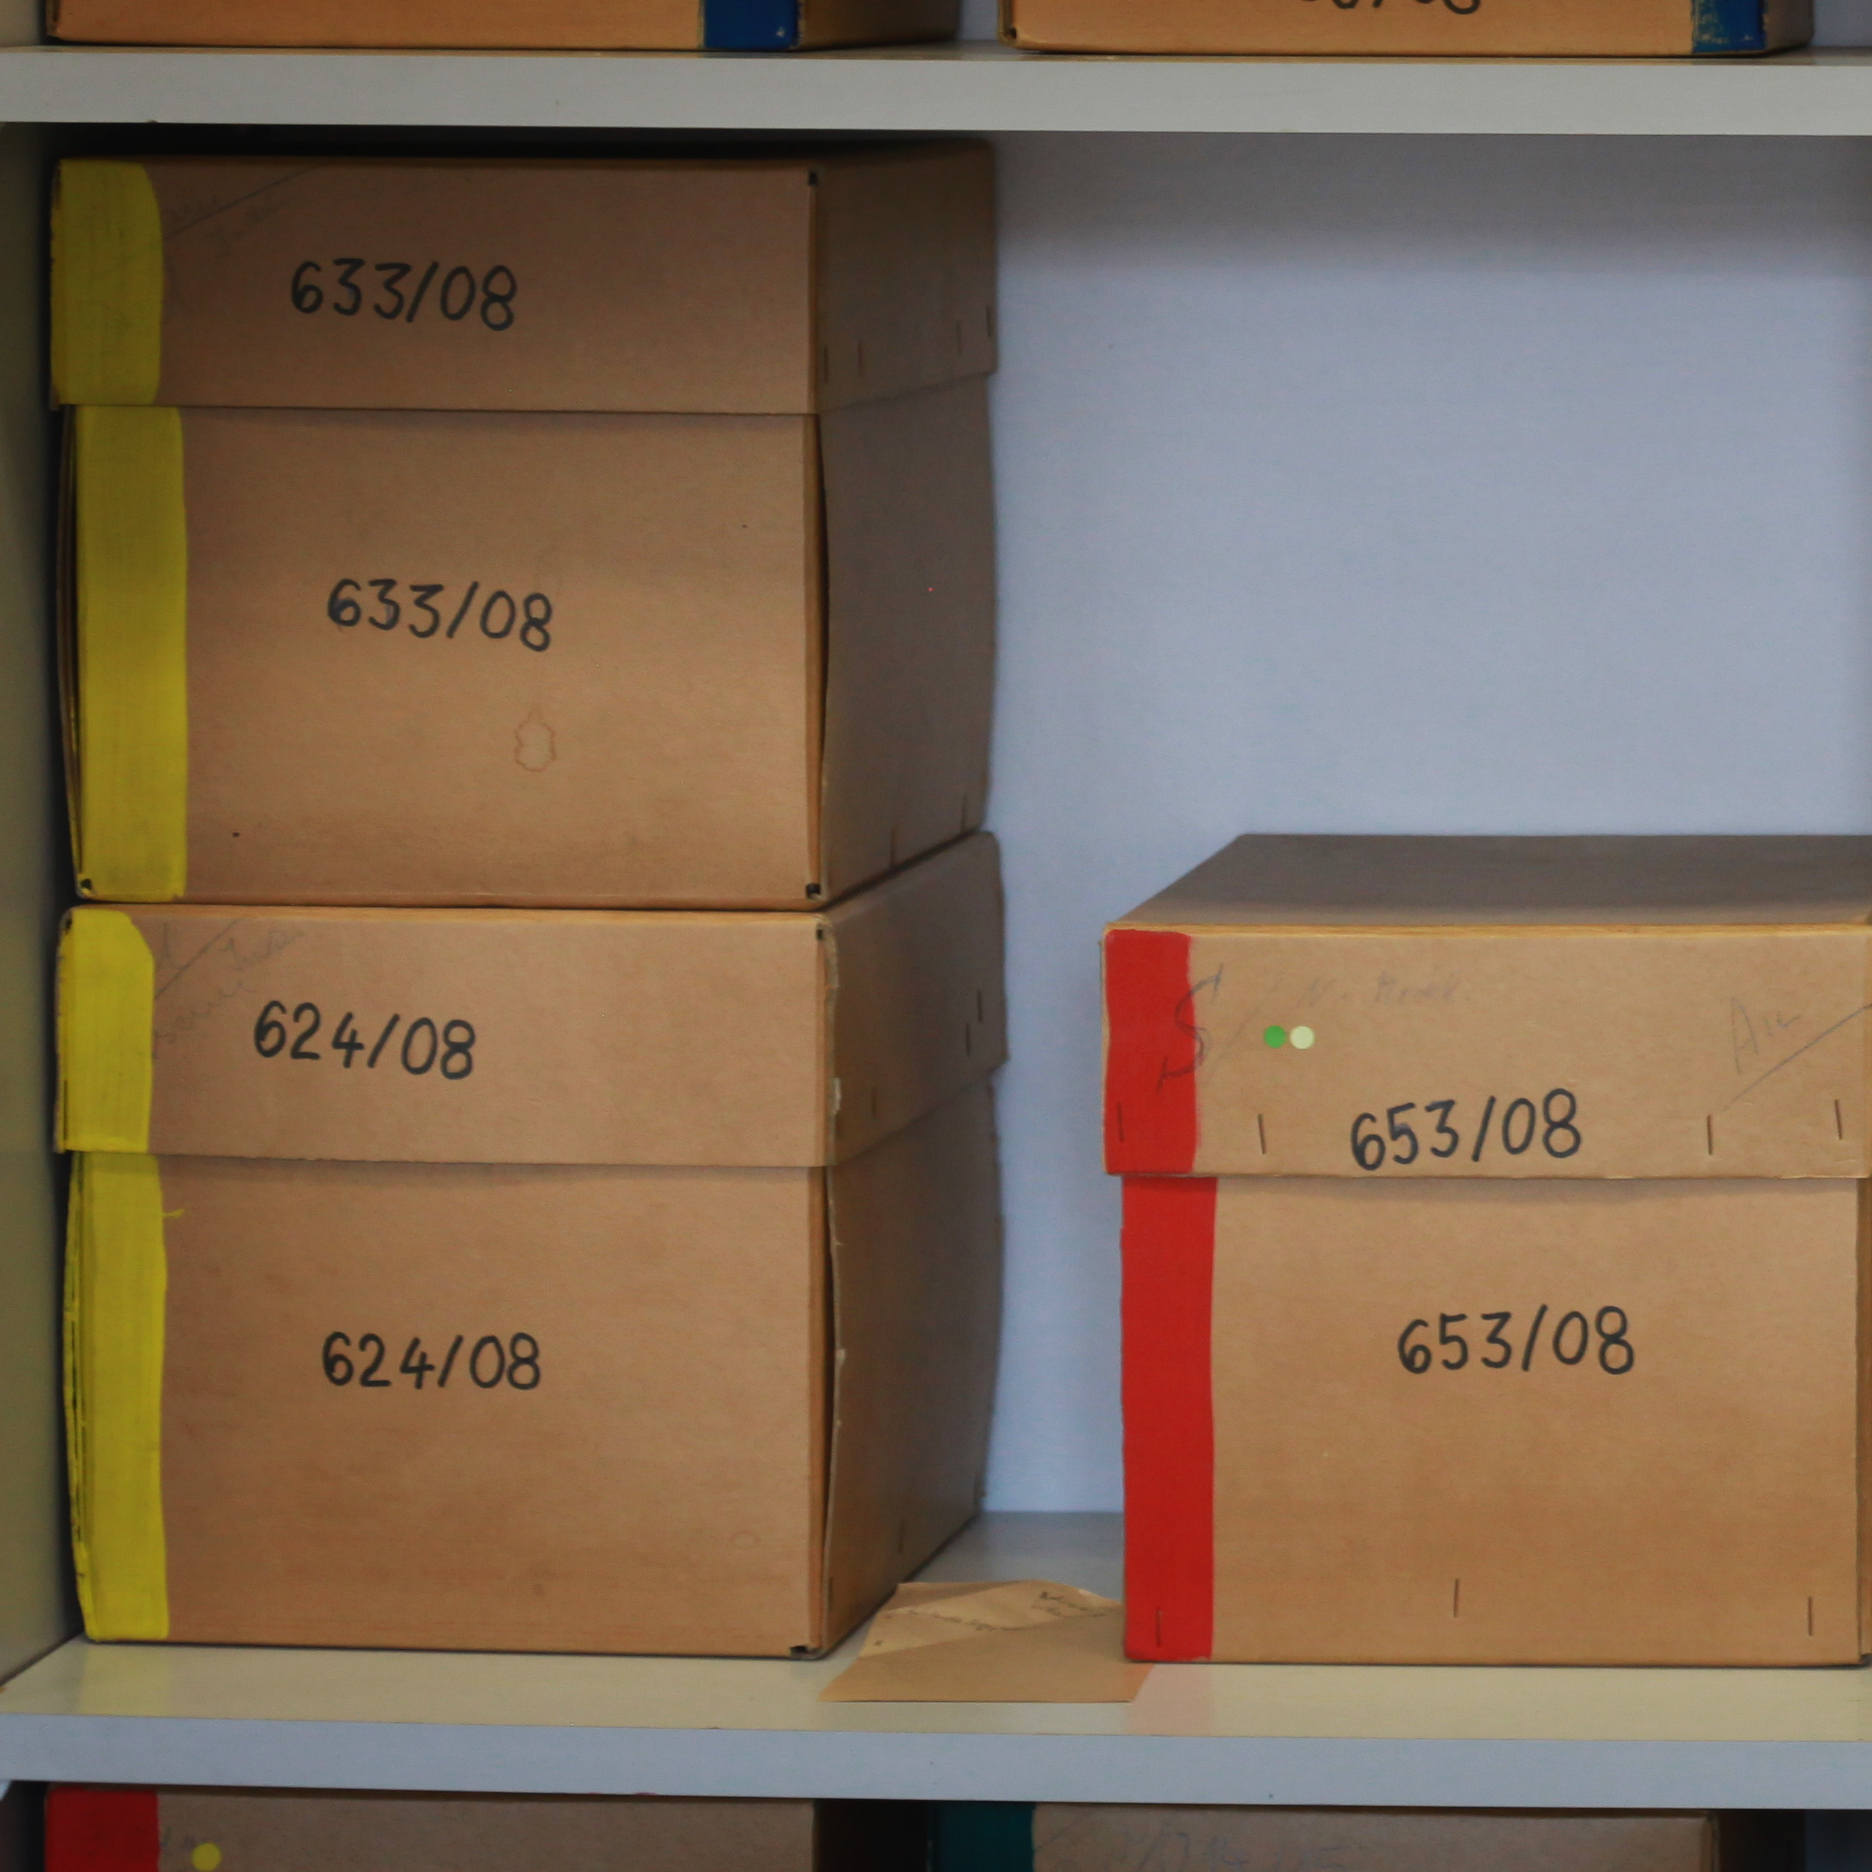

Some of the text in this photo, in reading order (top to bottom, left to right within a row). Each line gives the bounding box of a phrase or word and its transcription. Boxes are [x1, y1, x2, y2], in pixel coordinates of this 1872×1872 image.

[291, 258, 518, 331] 633/08
[327, 578, 554, 653] 633/08
[254, 1000, 476, 1080] 624/08
[1349, 1087, 1582, 1171] 653/08
[322, 1331, 541, 1391] 624/08
[1397, 1304, 1636, 1375] 653/08
